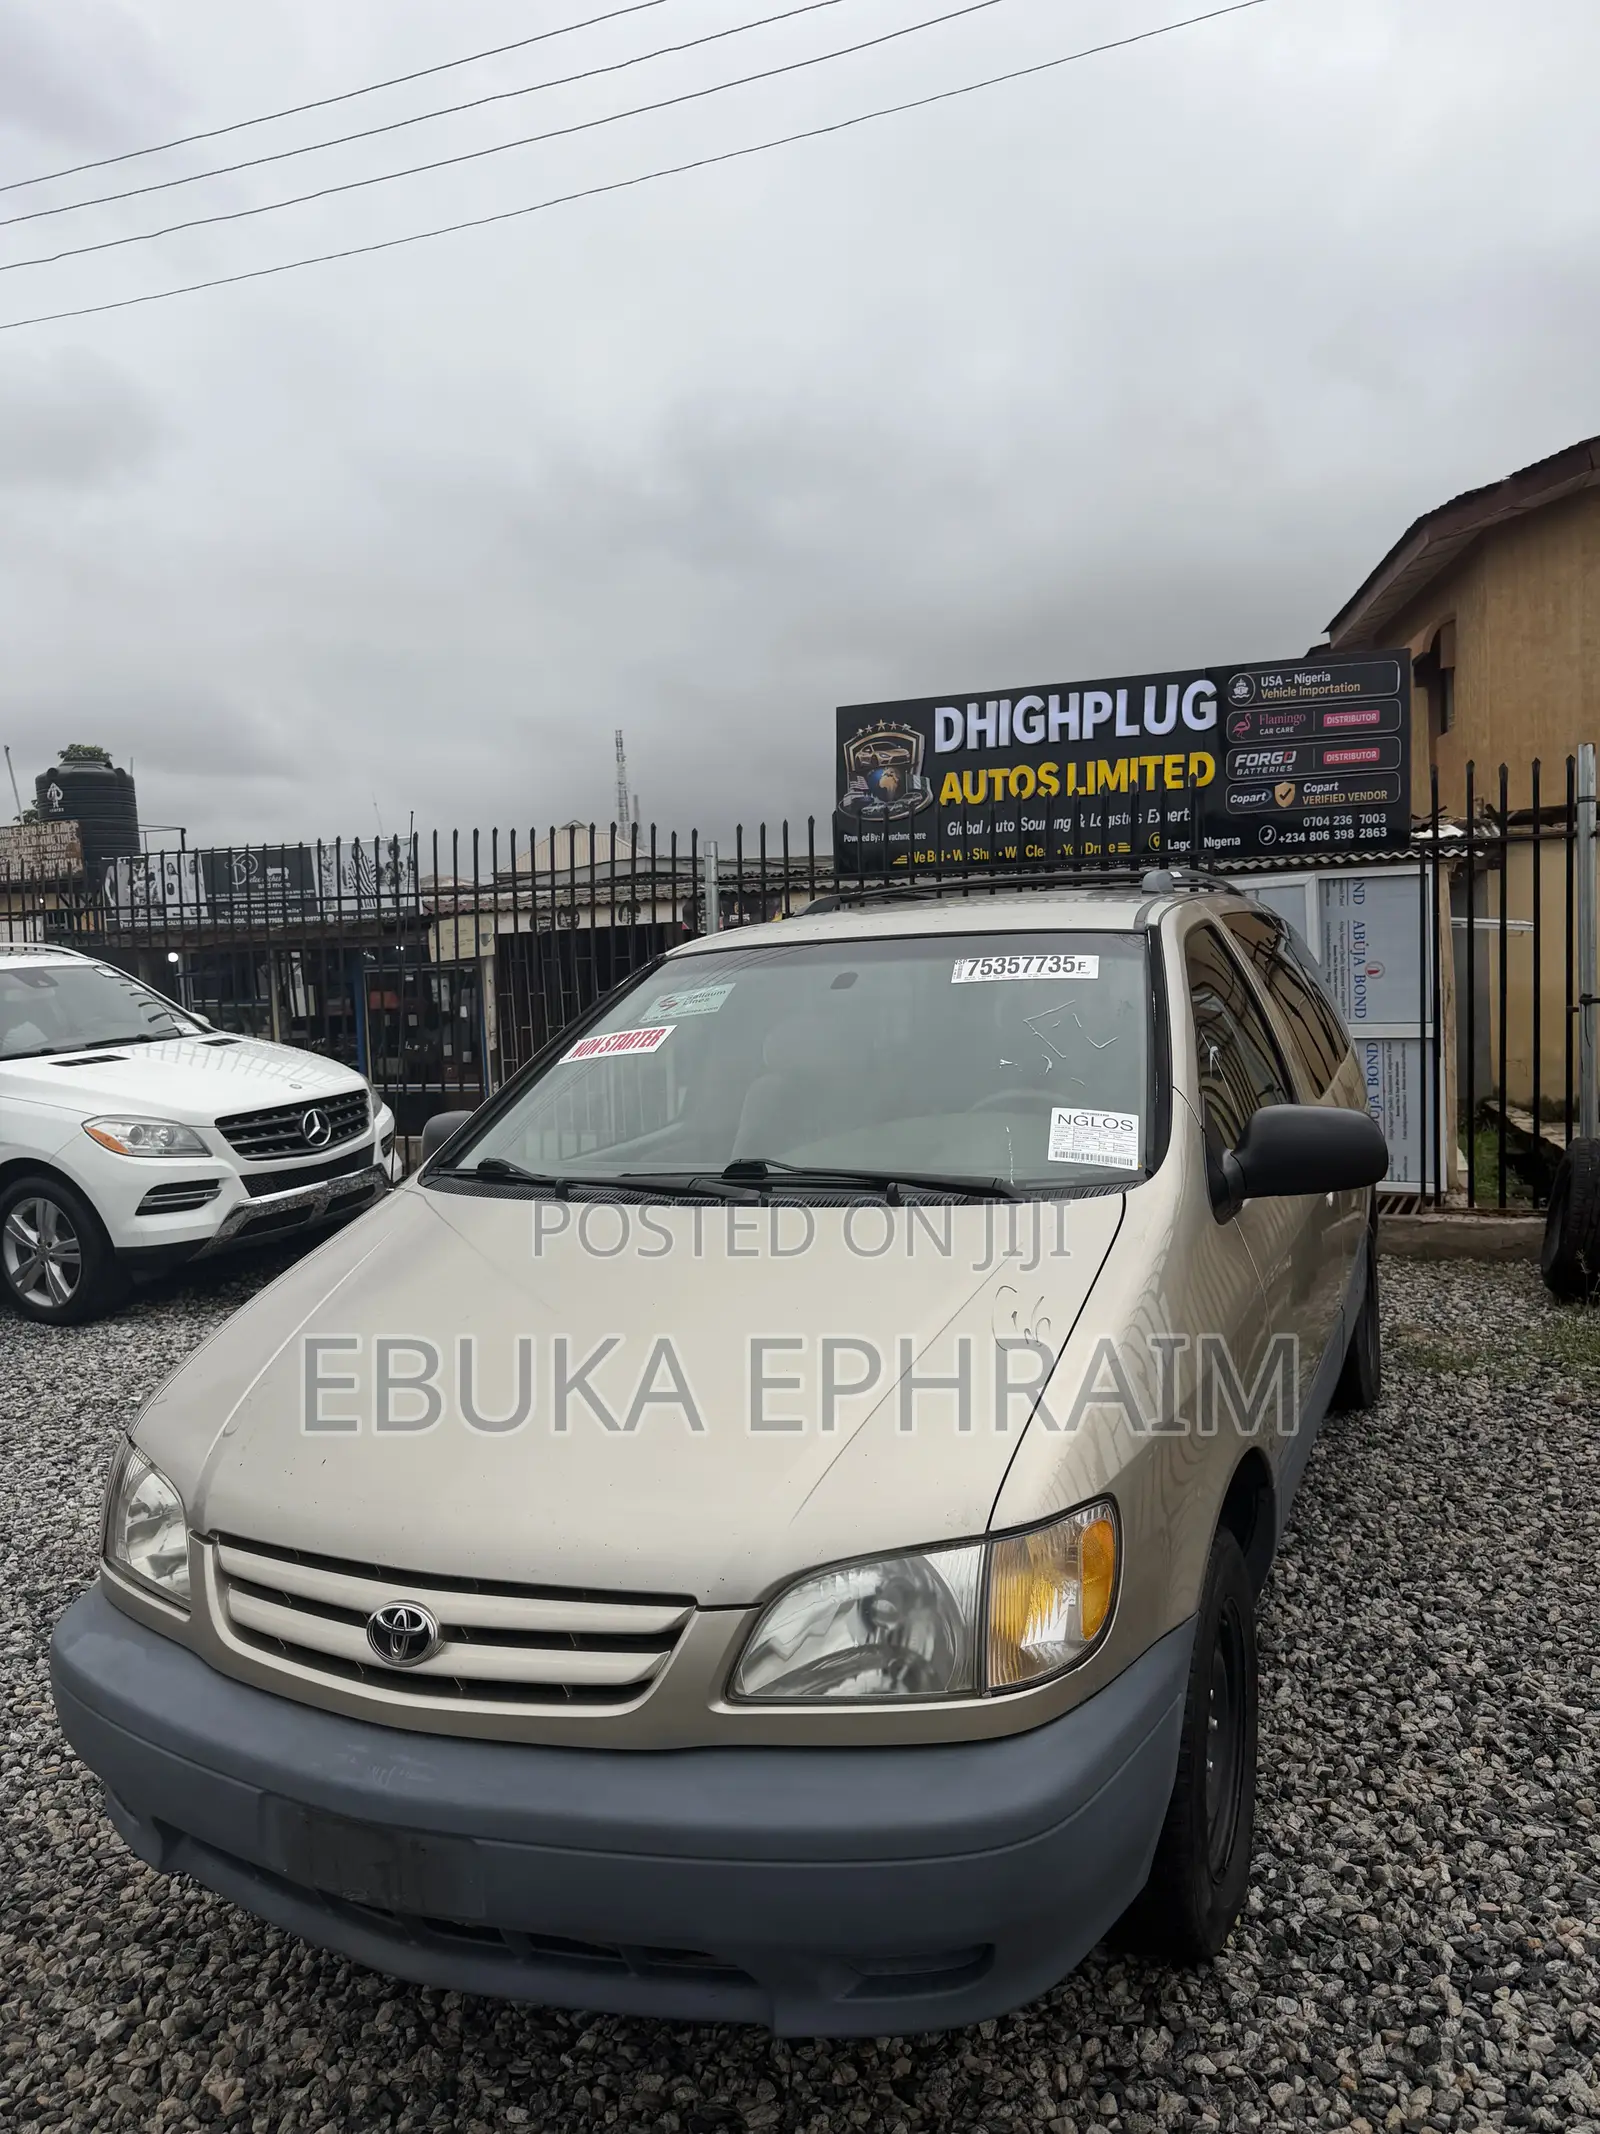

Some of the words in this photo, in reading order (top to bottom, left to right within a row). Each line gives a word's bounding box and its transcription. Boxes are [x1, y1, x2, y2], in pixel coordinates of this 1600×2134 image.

[1261, 676, 1282, 687] USA
[1294, 671, 1331, 685] Nigeria
[1261, 686, 1297, 699] Vehicle
[1299, 682, 1361, 697] Importation
[934, 680, 1217, 753] DHIGHPLUG
[1259, 713, 1307, 727] Flamingo
[1326, 713, 1377, 725] DISTRIBUTOR
[1276, 726, 1295, 734] CARE
[1326, 751, 1377, 763] DISTRIBUTOR
[1237, 765, 1293, 775] BATTERIES
[939, 763, 1060, 806] AUTOS
[1067, 751, 1216, 798] LIMITED
[1303, 782, 1339, 794] Copart
[1230, 792, 1267, 805] Copart
[1302, 793, 1345, 805] VERIFIED
[1348, 790, 1388, 802] VENDOR
[1021, 816, 1071, 832] Souring
[1303, 817, 1330, 828] 0704
[1333, 815, 1353, 826] 236
[1359, 813, 1386, 824] 7003
[844, 833, 870, 843] Powed
[1278, 832, 1306, 844] +234
[1309, 831, 1330, 841] 806
[1333, 829, 1355, 840] 398
[1359, 827, 1387, 838] 2863
[973, 848, 992, 861] Shi
[1025, 845, 1046, 858] Cle
[1085, 843, 1115, 855] Drie
[1168, 839, 1191, 852] Lago
[1203, 836, 1241, 849] Nigeria
[967, 956, 1075, 976] 75357735
[1078, 962, 1086, 971] F
[1353, 974, 1367, 1019] BOND
[569, 1036, 606, 1059] NON
[598, 1028, 667, 1053] STARTER
[1366, 1042, 1379, 1087] BOND
[1368, 1094, 1384, 1124] UJA
[1057, 1113, 1133, 1131] NGLOS
